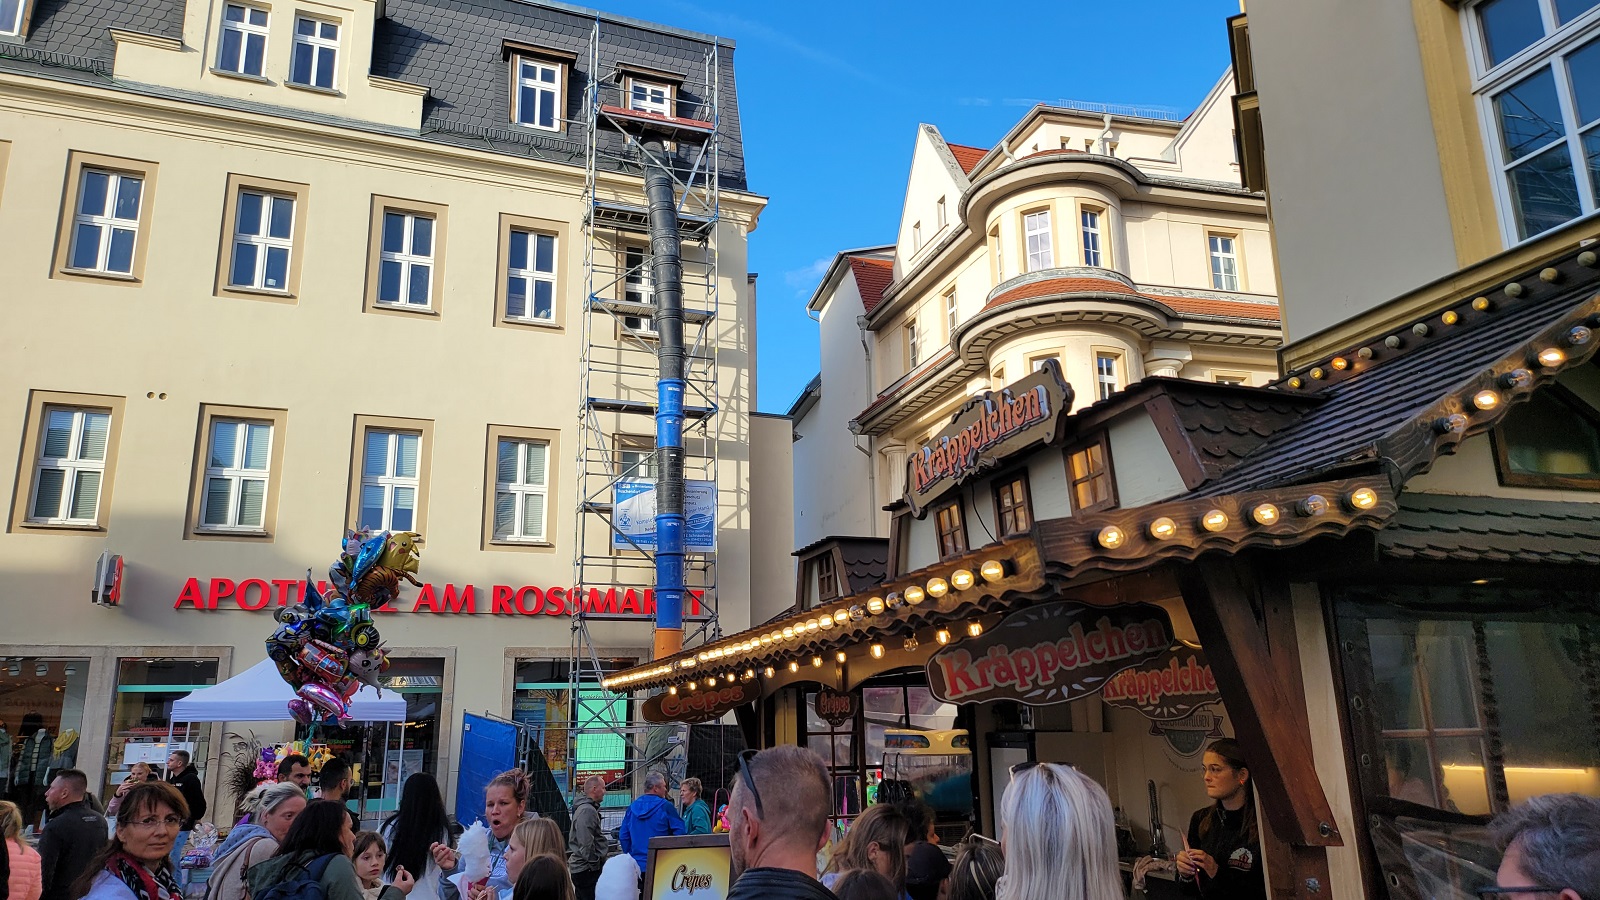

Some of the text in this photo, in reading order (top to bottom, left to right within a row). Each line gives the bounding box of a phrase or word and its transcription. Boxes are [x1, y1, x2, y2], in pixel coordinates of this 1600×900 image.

[911, 386, 1047, 491] Kräppelchen
[412, 583, 476, 614] AM
[491, 584, 706, 616] ROSSMART
[936, 616, 1169, 699] Kräppelchen
[671, 864, 713, 895] Crêpes
